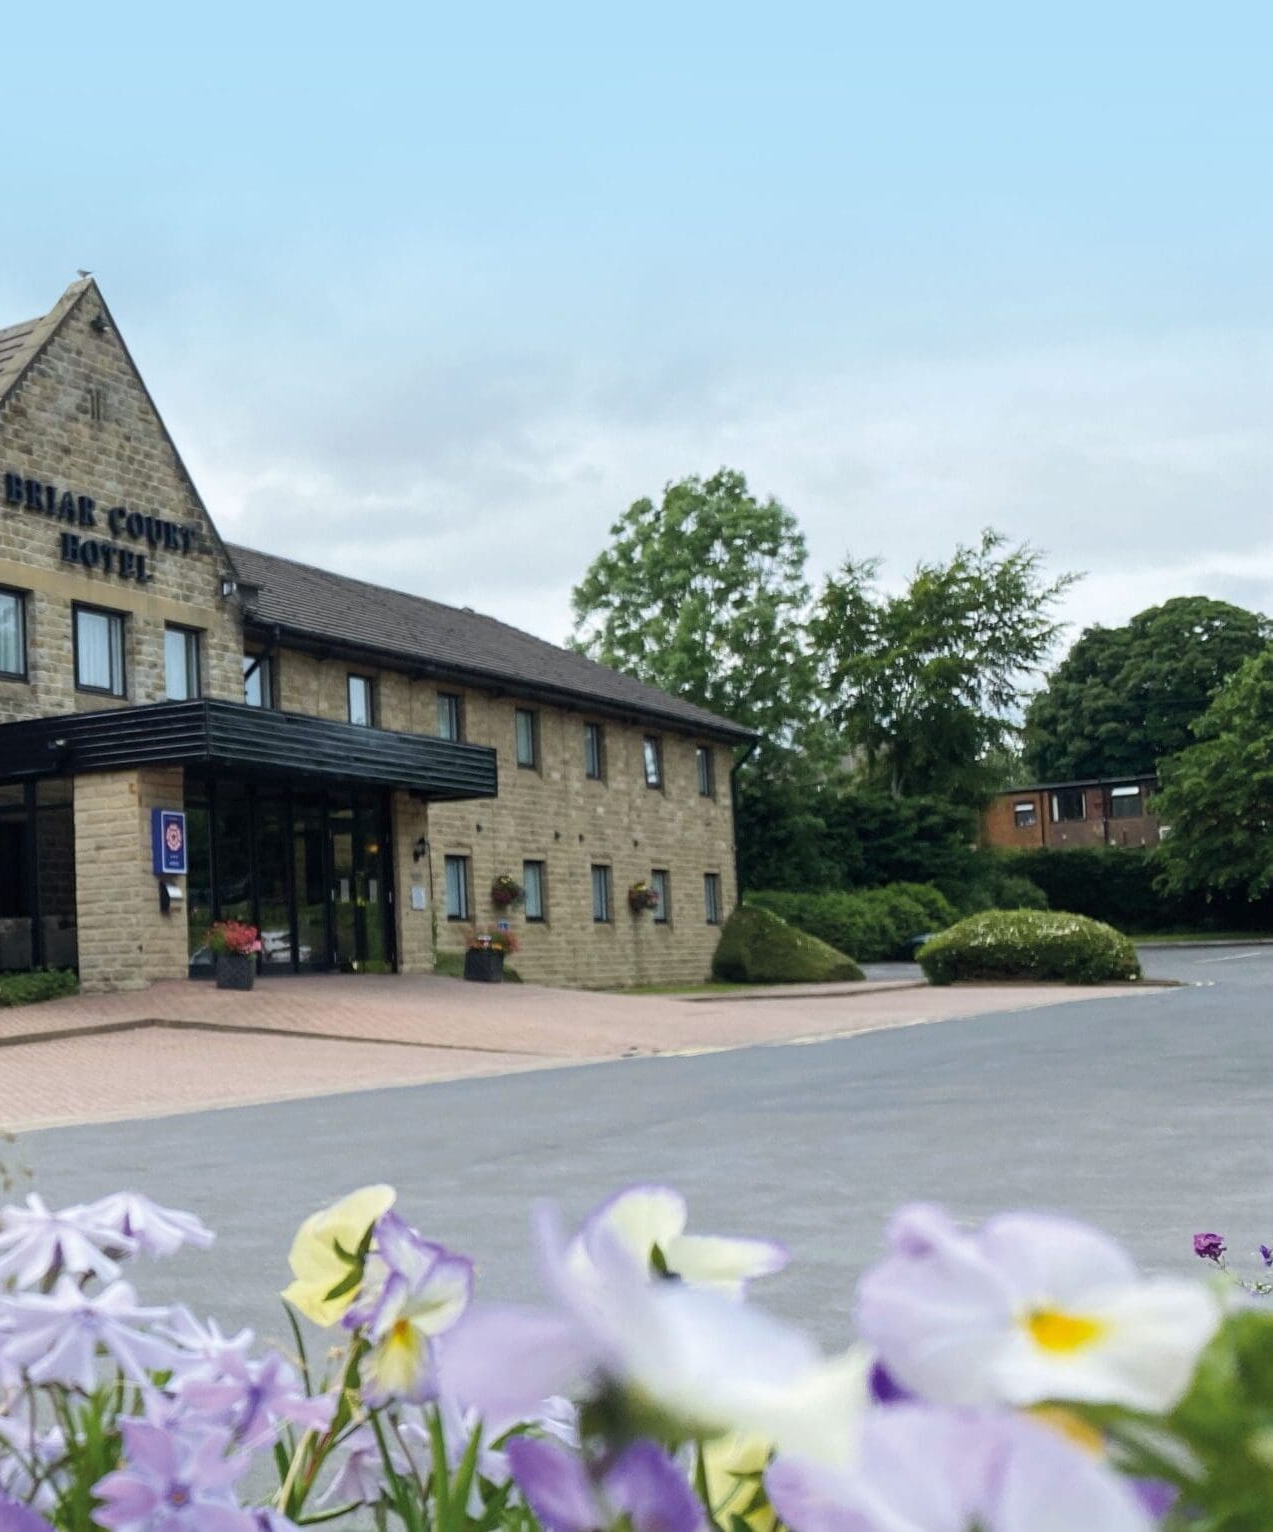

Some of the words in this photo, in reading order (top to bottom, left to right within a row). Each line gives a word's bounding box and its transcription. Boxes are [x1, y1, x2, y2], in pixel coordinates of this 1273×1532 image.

[5, 472, 97, 527] BRIAR
[108, 507, 197, 554] COURT
[61, 532, 153, 583] HOTEL
